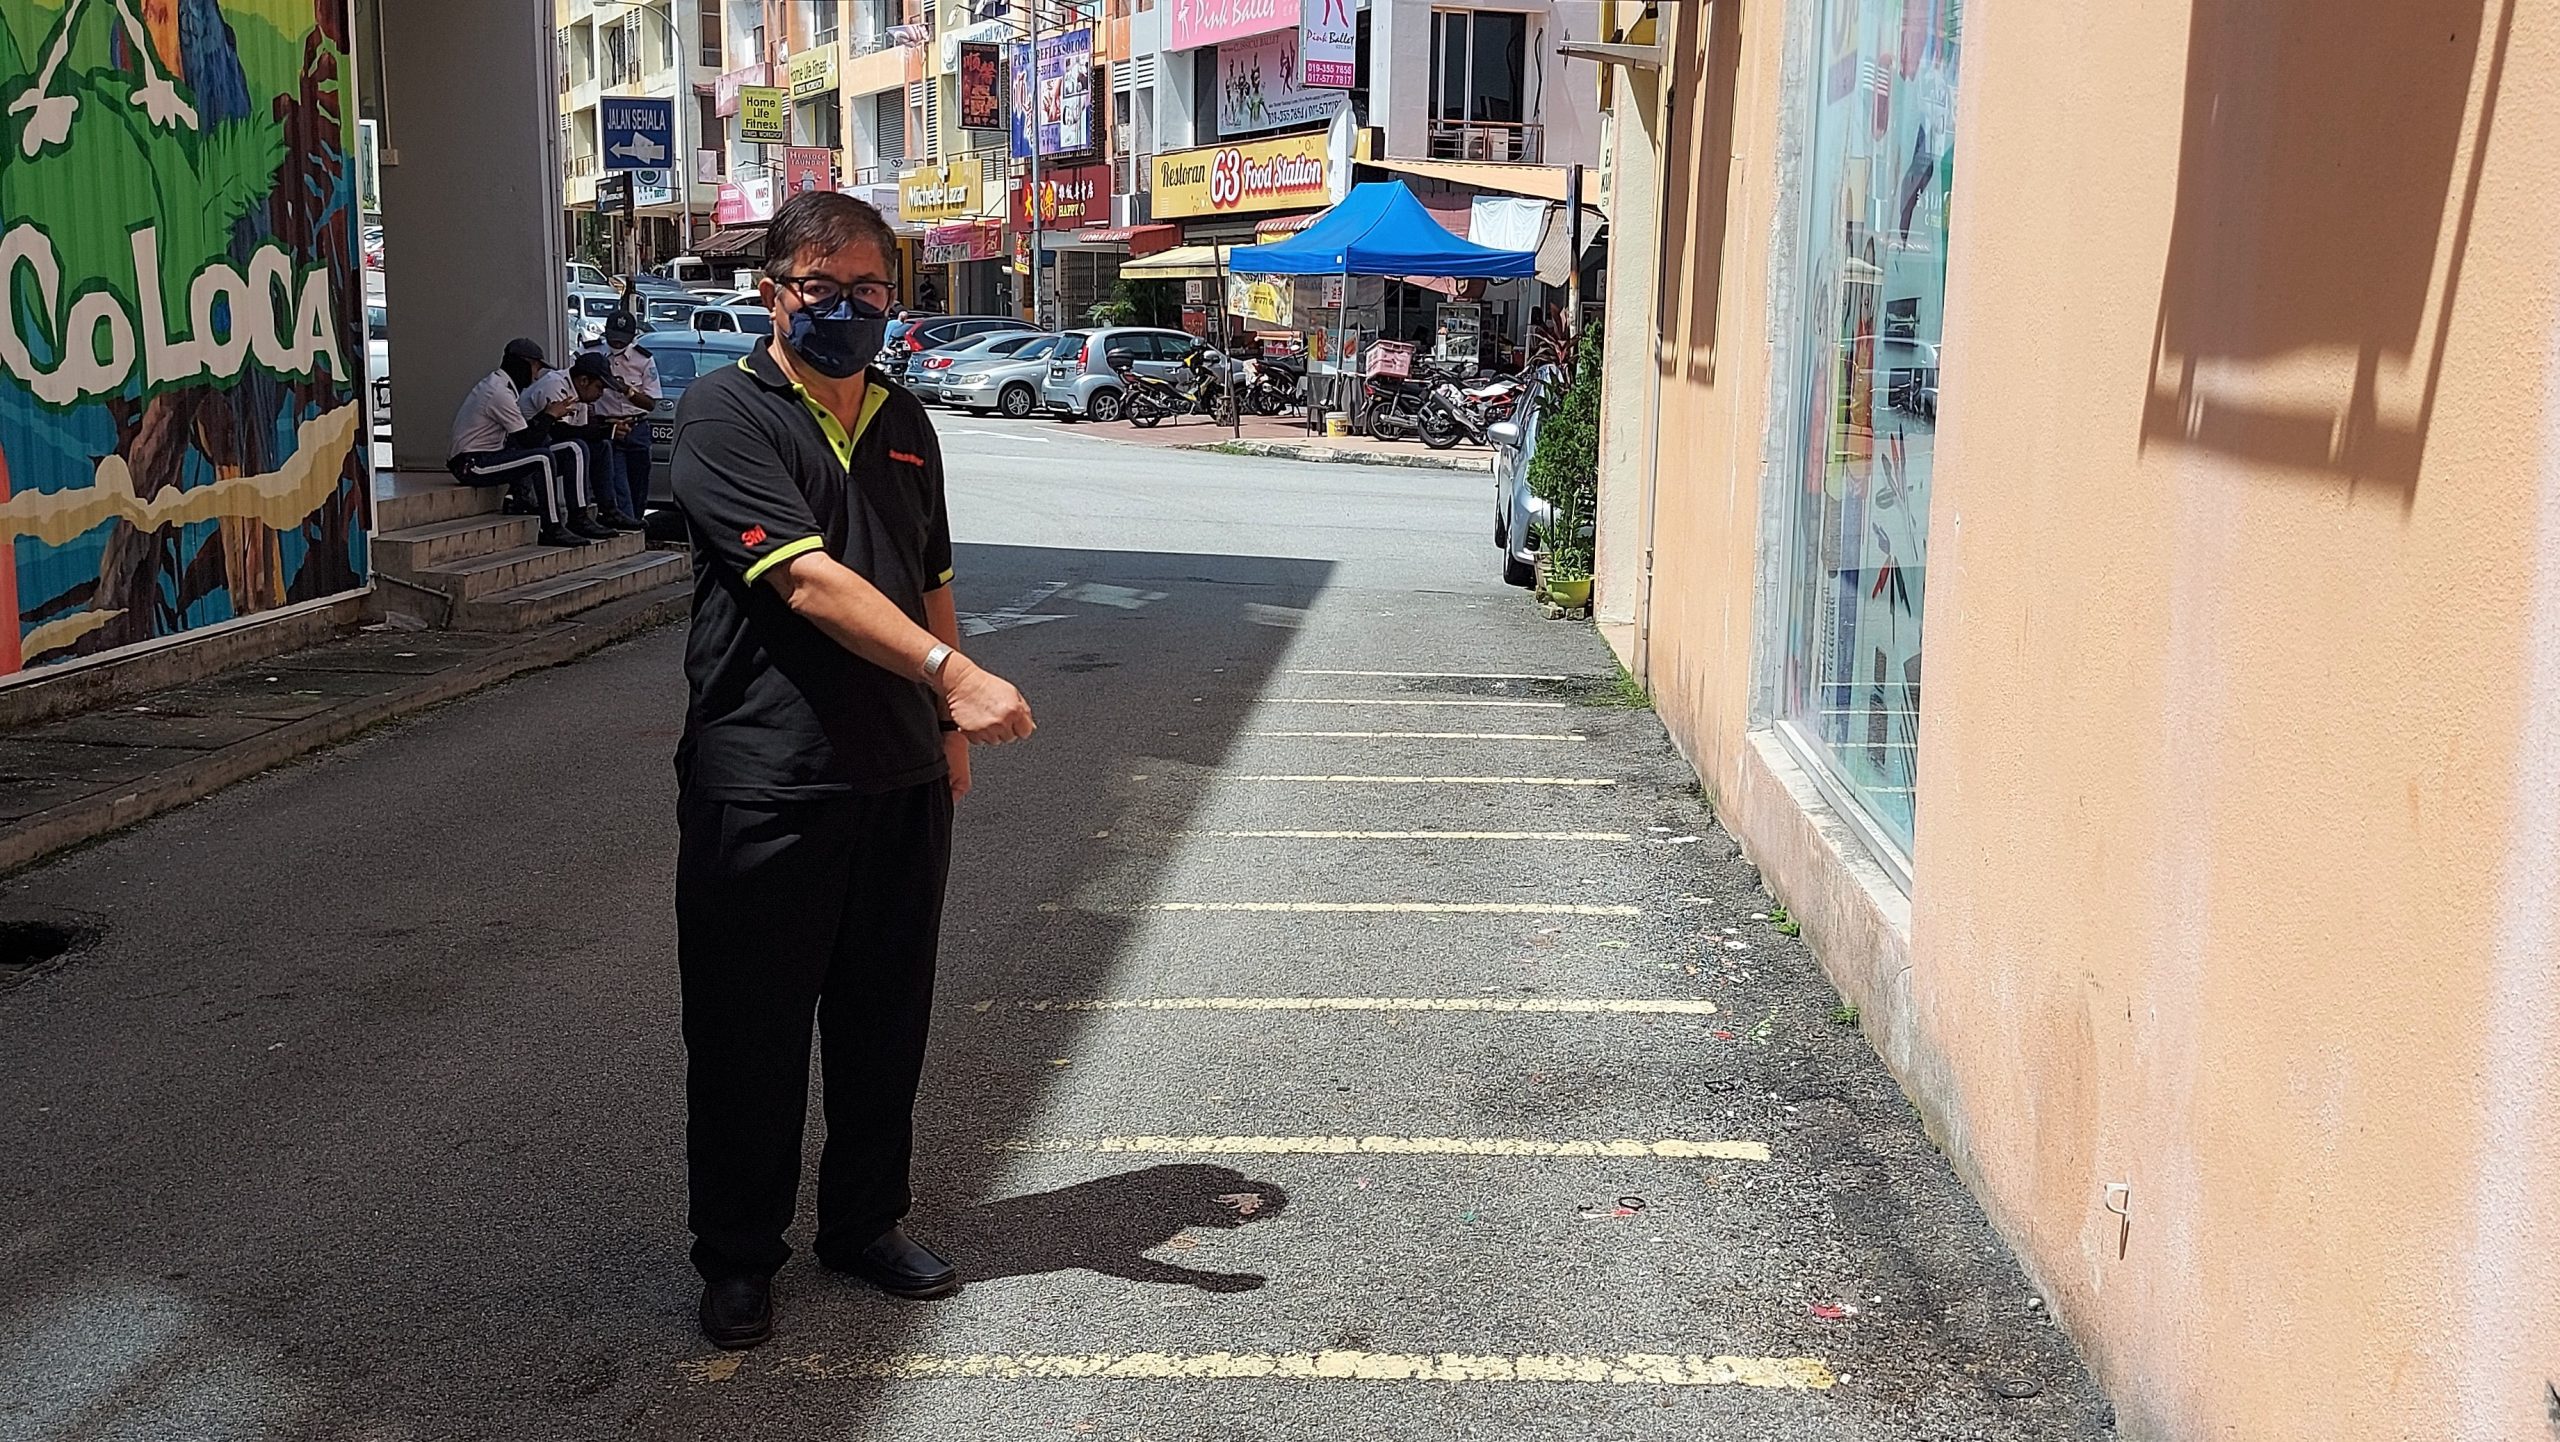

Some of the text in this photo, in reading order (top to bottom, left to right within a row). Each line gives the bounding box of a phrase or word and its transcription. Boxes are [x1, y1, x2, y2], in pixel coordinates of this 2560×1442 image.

[1306, 28, 1354, 46] Pink Ballet
[1013, 50, 1032, 67] PUSA
[746, 96, 776, 108] Home
[607, 108, 666, 131] JALAN SEHALA
[753, 107, 770, 119] Life
[745, 118, 778, 130] Fitness
[1161, 149, 1322, 205] Restoran 63 Food Station
[1058, 203, 1079, 218] HAPPY
